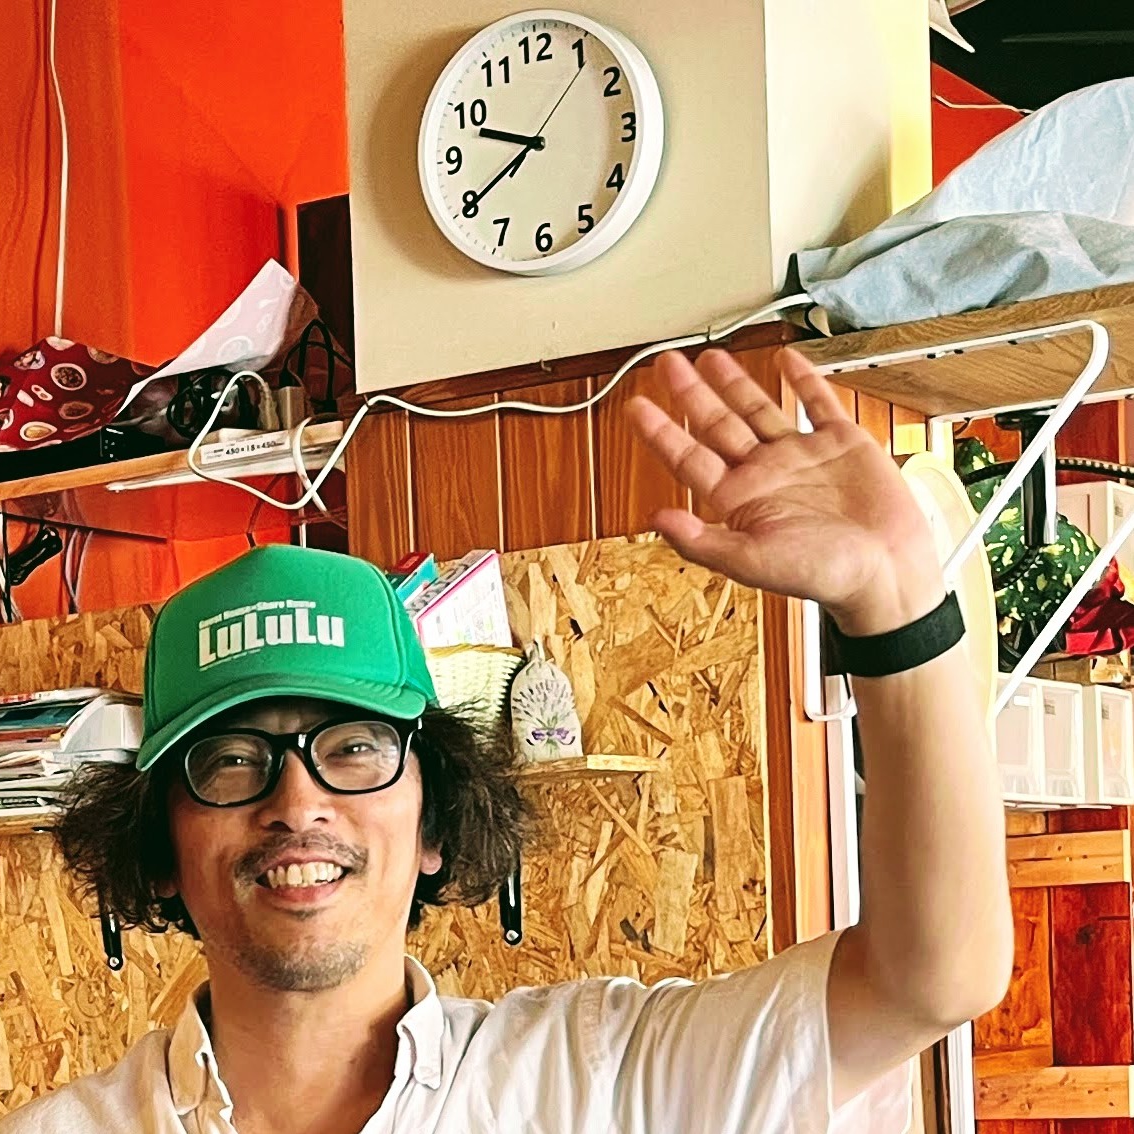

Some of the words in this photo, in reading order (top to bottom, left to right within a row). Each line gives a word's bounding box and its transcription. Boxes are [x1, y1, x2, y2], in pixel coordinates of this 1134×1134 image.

[518, 32, 553, 64] 12
[571, 38, 585, 69] 1
[481, 56, 510, 87] 11
[603, 66, 622, 97] 2
[454, 98, 487, 129] 10
[621, 112, 637, 142] 3
[445, 146, 463, 175] 9
[606, 163, 625, 193] 4
[461, 190, 479, 219] 8
[577, 203, 595, 234] 5
[492, 217, 511, 247] 7
[535, 222, 553, 253] 6
[199, 607, 345, 667] LuLuLu
